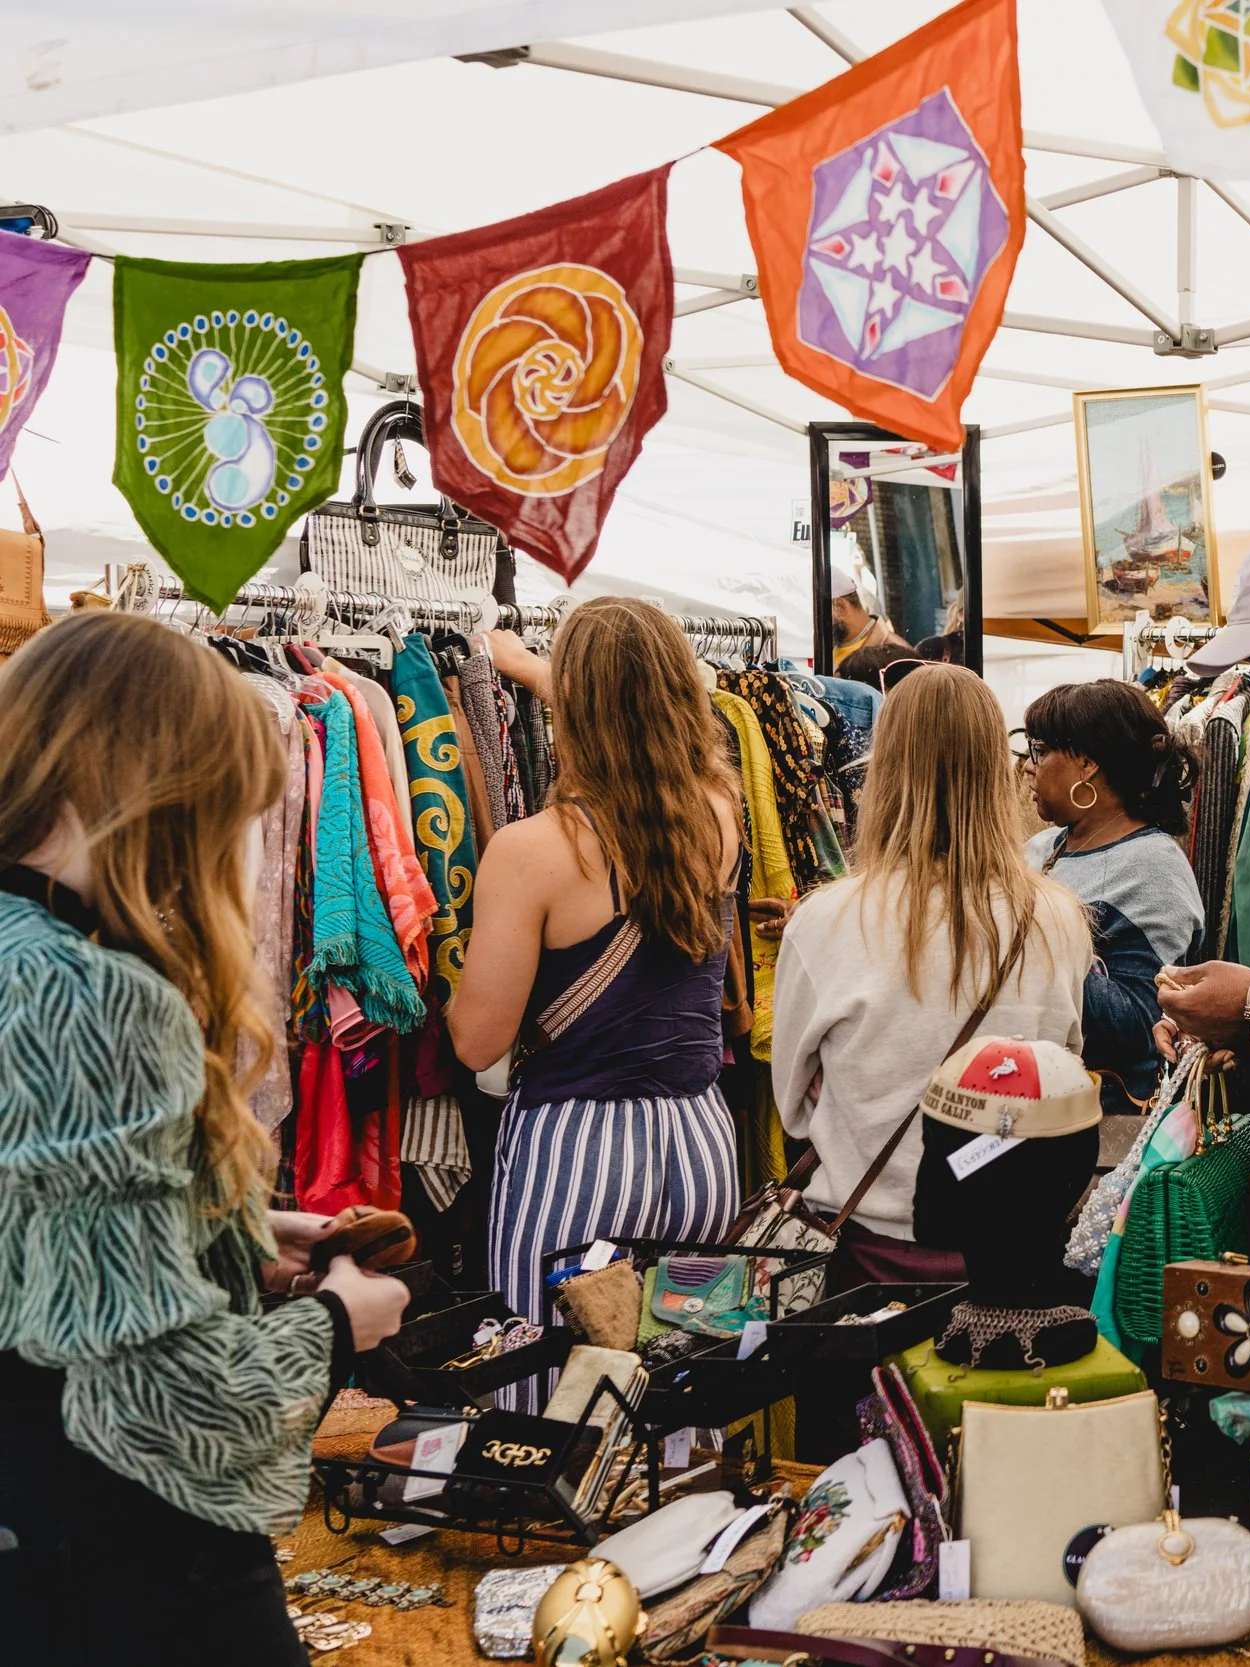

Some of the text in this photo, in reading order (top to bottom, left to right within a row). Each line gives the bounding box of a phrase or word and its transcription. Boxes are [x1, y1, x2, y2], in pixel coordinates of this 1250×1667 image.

[793, 520, 811, 541] Eu
[945, 1089, 987, 1110] CANYON
[941, 1102, 974, 1122] CALIF.
